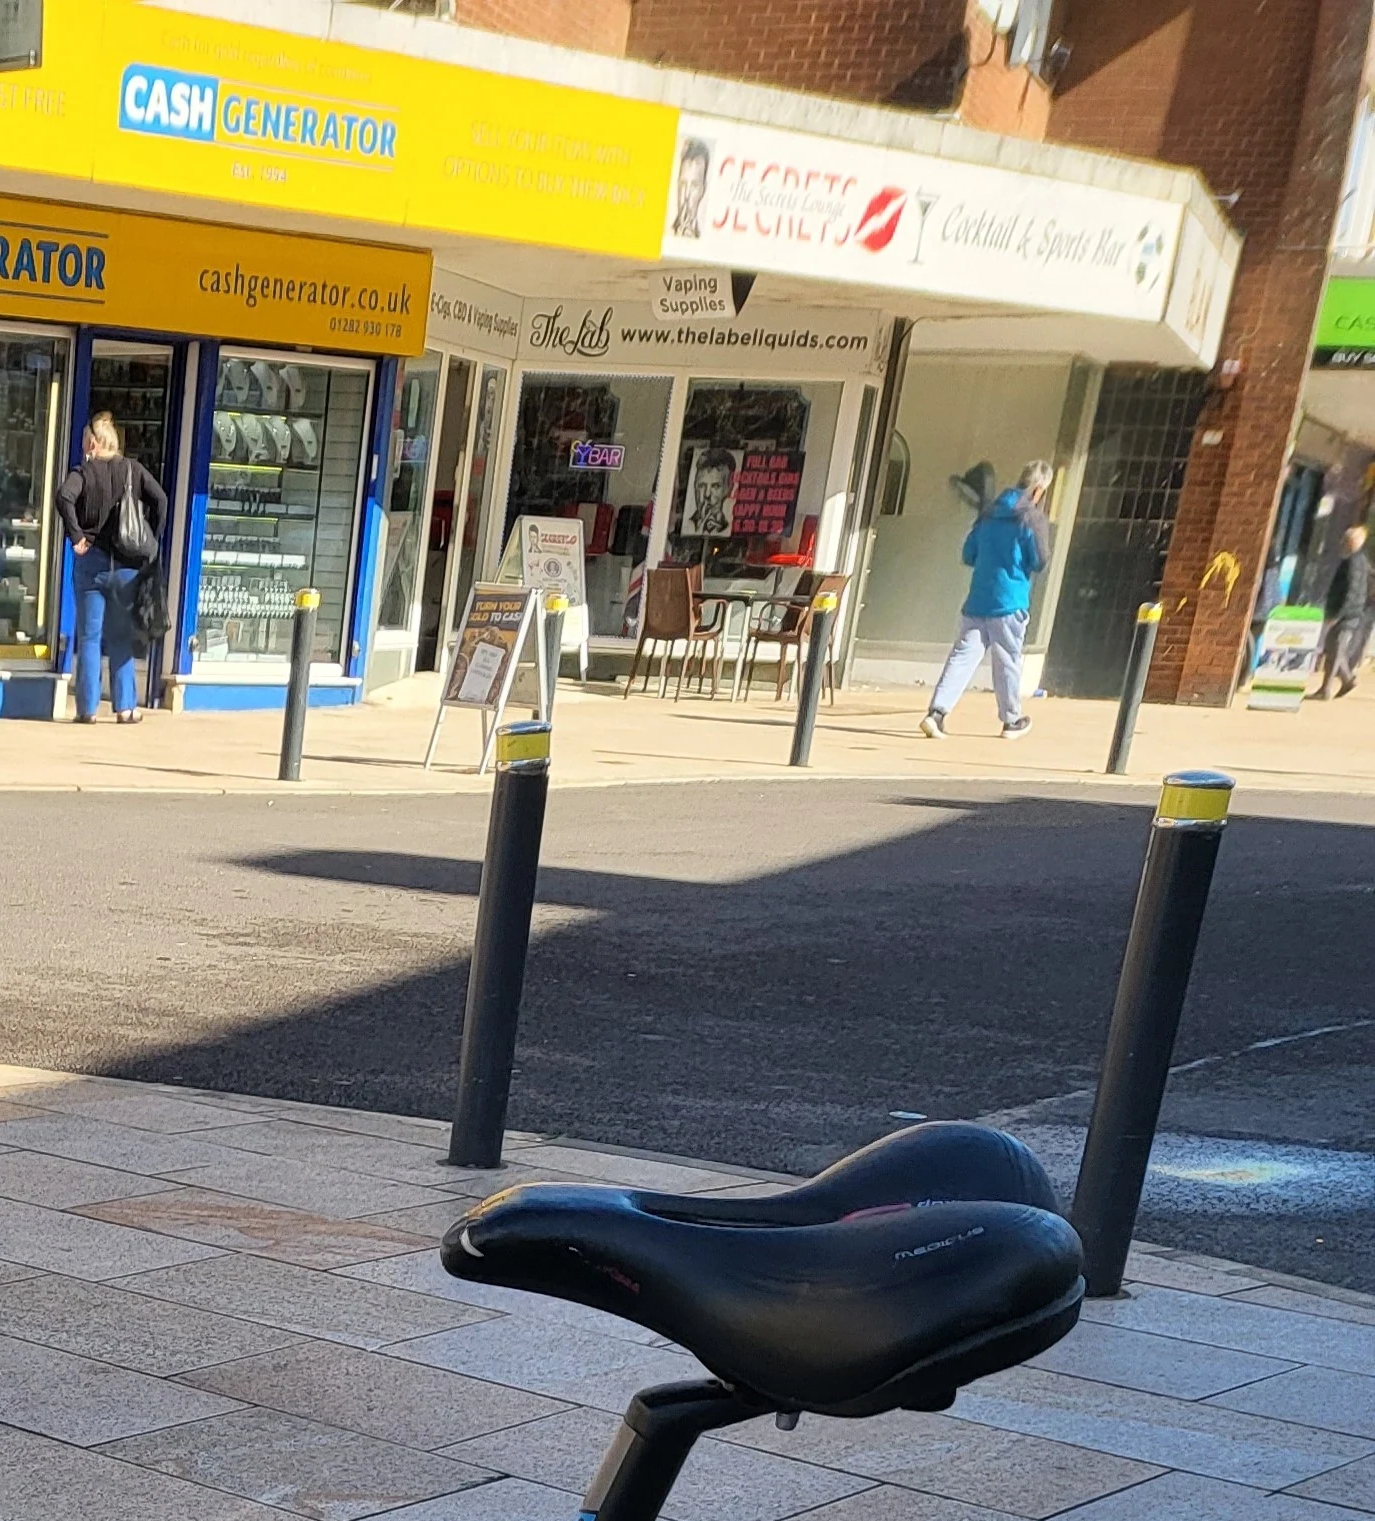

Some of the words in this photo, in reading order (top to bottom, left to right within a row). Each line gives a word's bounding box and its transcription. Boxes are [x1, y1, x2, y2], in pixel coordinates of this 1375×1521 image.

[125, 74, 214, 133] CASH
[222, 94, 397, 159] GENERATOR
[941, 202, 1020, 252] Cocktail
[1037, 217, 1089, 268] Sports
[1092, 227, 1125, 268] Bar
[198, 262, 412, 316] cashgenerator.co.uk
[662, 273, 718, 295] Vaping
[659, 297, 726, 316] Supplies
[329, 317, 361, 334] 01282
[362, 320, 381, 336] 930
[384, 323, 402, 338] 178
[529, 304, 571, 350] The
[620, 326, 869, 351] www.thelabeliquids.com
[587, 448, 621, 466] BAR
